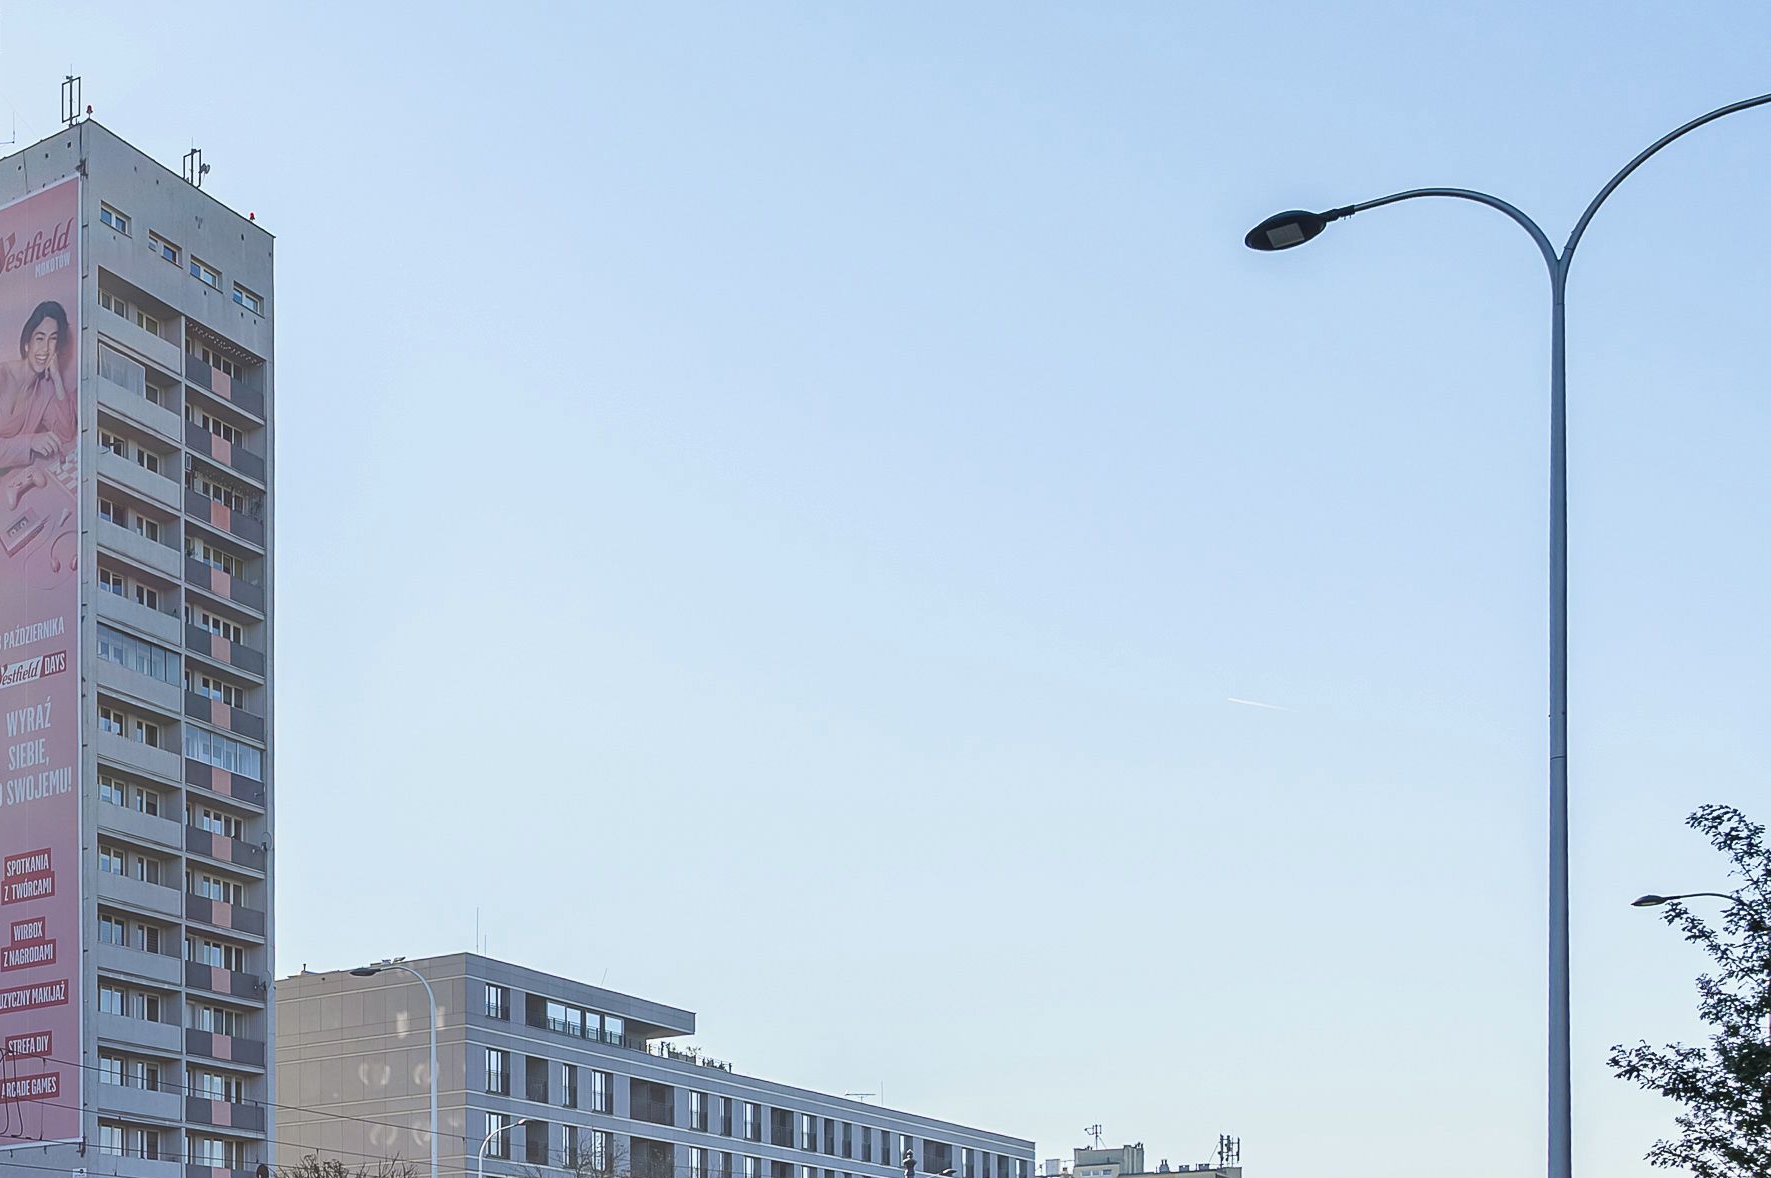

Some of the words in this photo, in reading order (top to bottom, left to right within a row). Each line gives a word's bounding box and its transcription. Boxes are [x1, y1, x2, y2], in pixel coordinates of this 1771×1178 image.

[3, 616, 65, 650] PAŹDZIERNIKA
[44, 653, 65, 675] DAYS
[6, 695, 52, 737] WYRAŹ
[8, 738, 50, 771] SIEBIE,
[6, 766, 72, 807] SWOJEMU!
[6, 853, 49, 877] SPOTKANIA
[4, 886, 9, 901] Z
[11, 876, 52, 899] TWÓRCAMI
[13, 921, 43, 942] WIRBOX
[3, 952, 9, 967] Z
[9, 943, 53, 966] NAGRODAMI
[31, 980, 65, 1006] MAKIJAŻ
[8, 1038, 35, 1056] STREFA
[36, 1035, 49, 1053] DIY
[1, 1080, 30, 1099] ARCADE
[31, 1076, 57, 1095] GAMES
